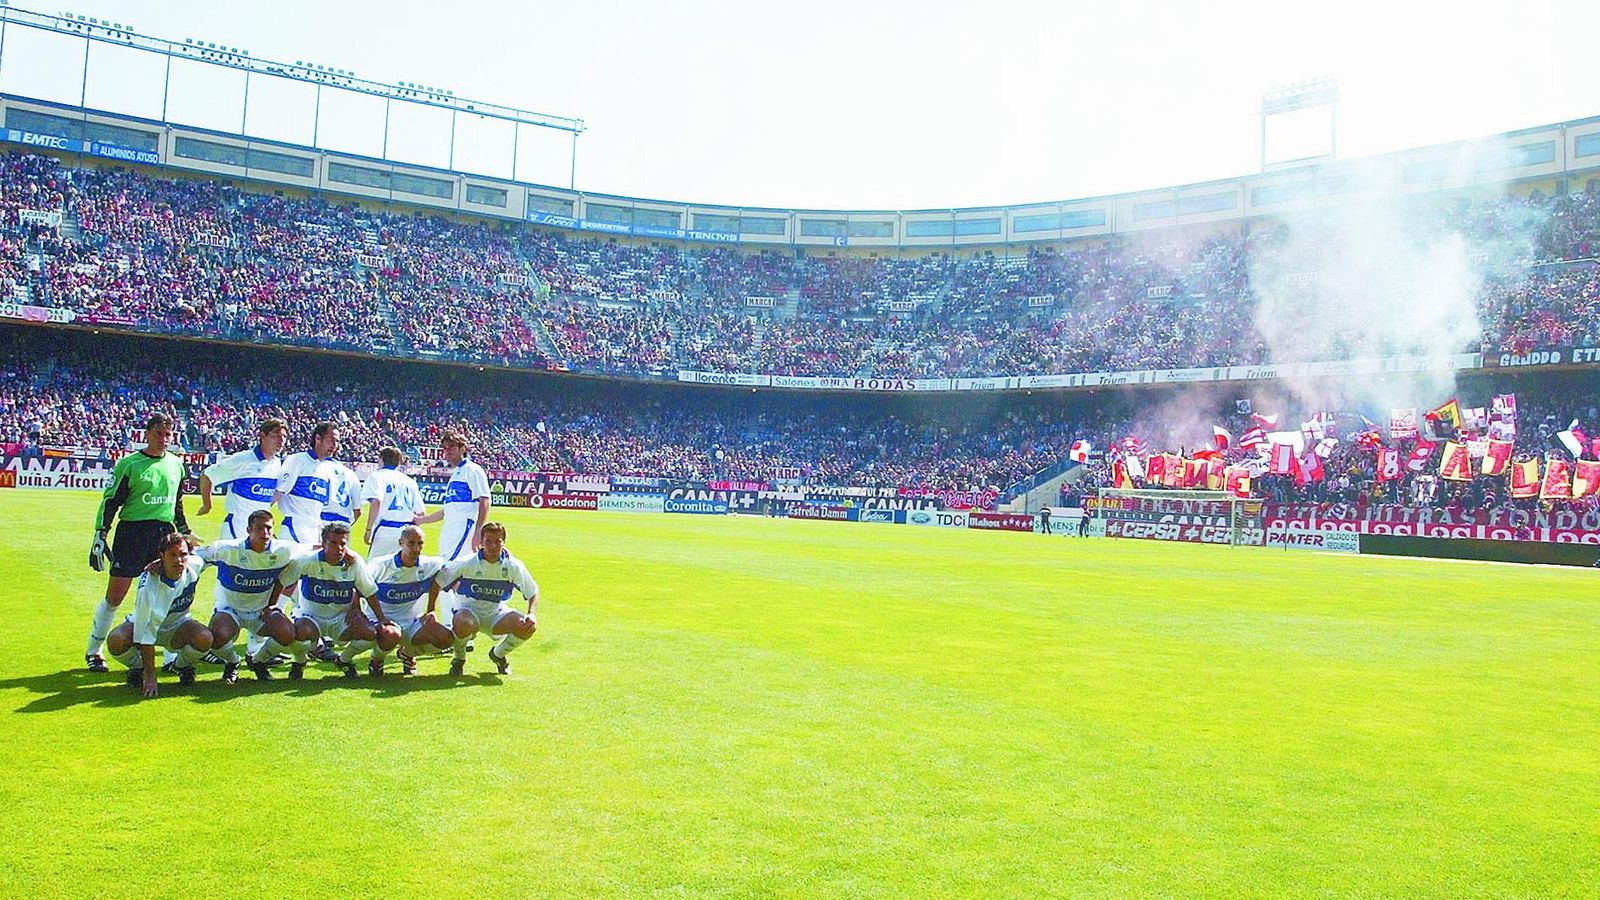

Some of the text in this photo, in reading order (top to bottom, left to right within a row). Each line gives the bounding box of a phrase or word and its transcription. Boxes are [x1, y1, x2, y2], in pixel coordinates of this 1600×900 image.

[22, 132, 68, 149] EMTEC
[99, 146, 158, 164] ALUMINIOS AYUSO
[689, 231, 737, 241] TENOVIS
[853, 378, 917, 391] BODAS
[1099, 376, 1127, 385] Trium
[19, 472, 52, 488] viña
[386, 483, 416, 511] 20
[548, 499, 597, 508] vodafone
[599, 500, 663, 509] SIEMENS mobile
[664, 499, 713, 512] Coronita
[788, 506, 820, 517] Estrella
[821, 506, 848, 519] Damm
[936, 513, 966, 527] TDCi
[969, 518, 1000, 528] Mahou
[1121, 523, 1181, 541] CEPSA
[1268, 532, 1324, 547] PANTER
[234, 573, 273, 588] Canasta
